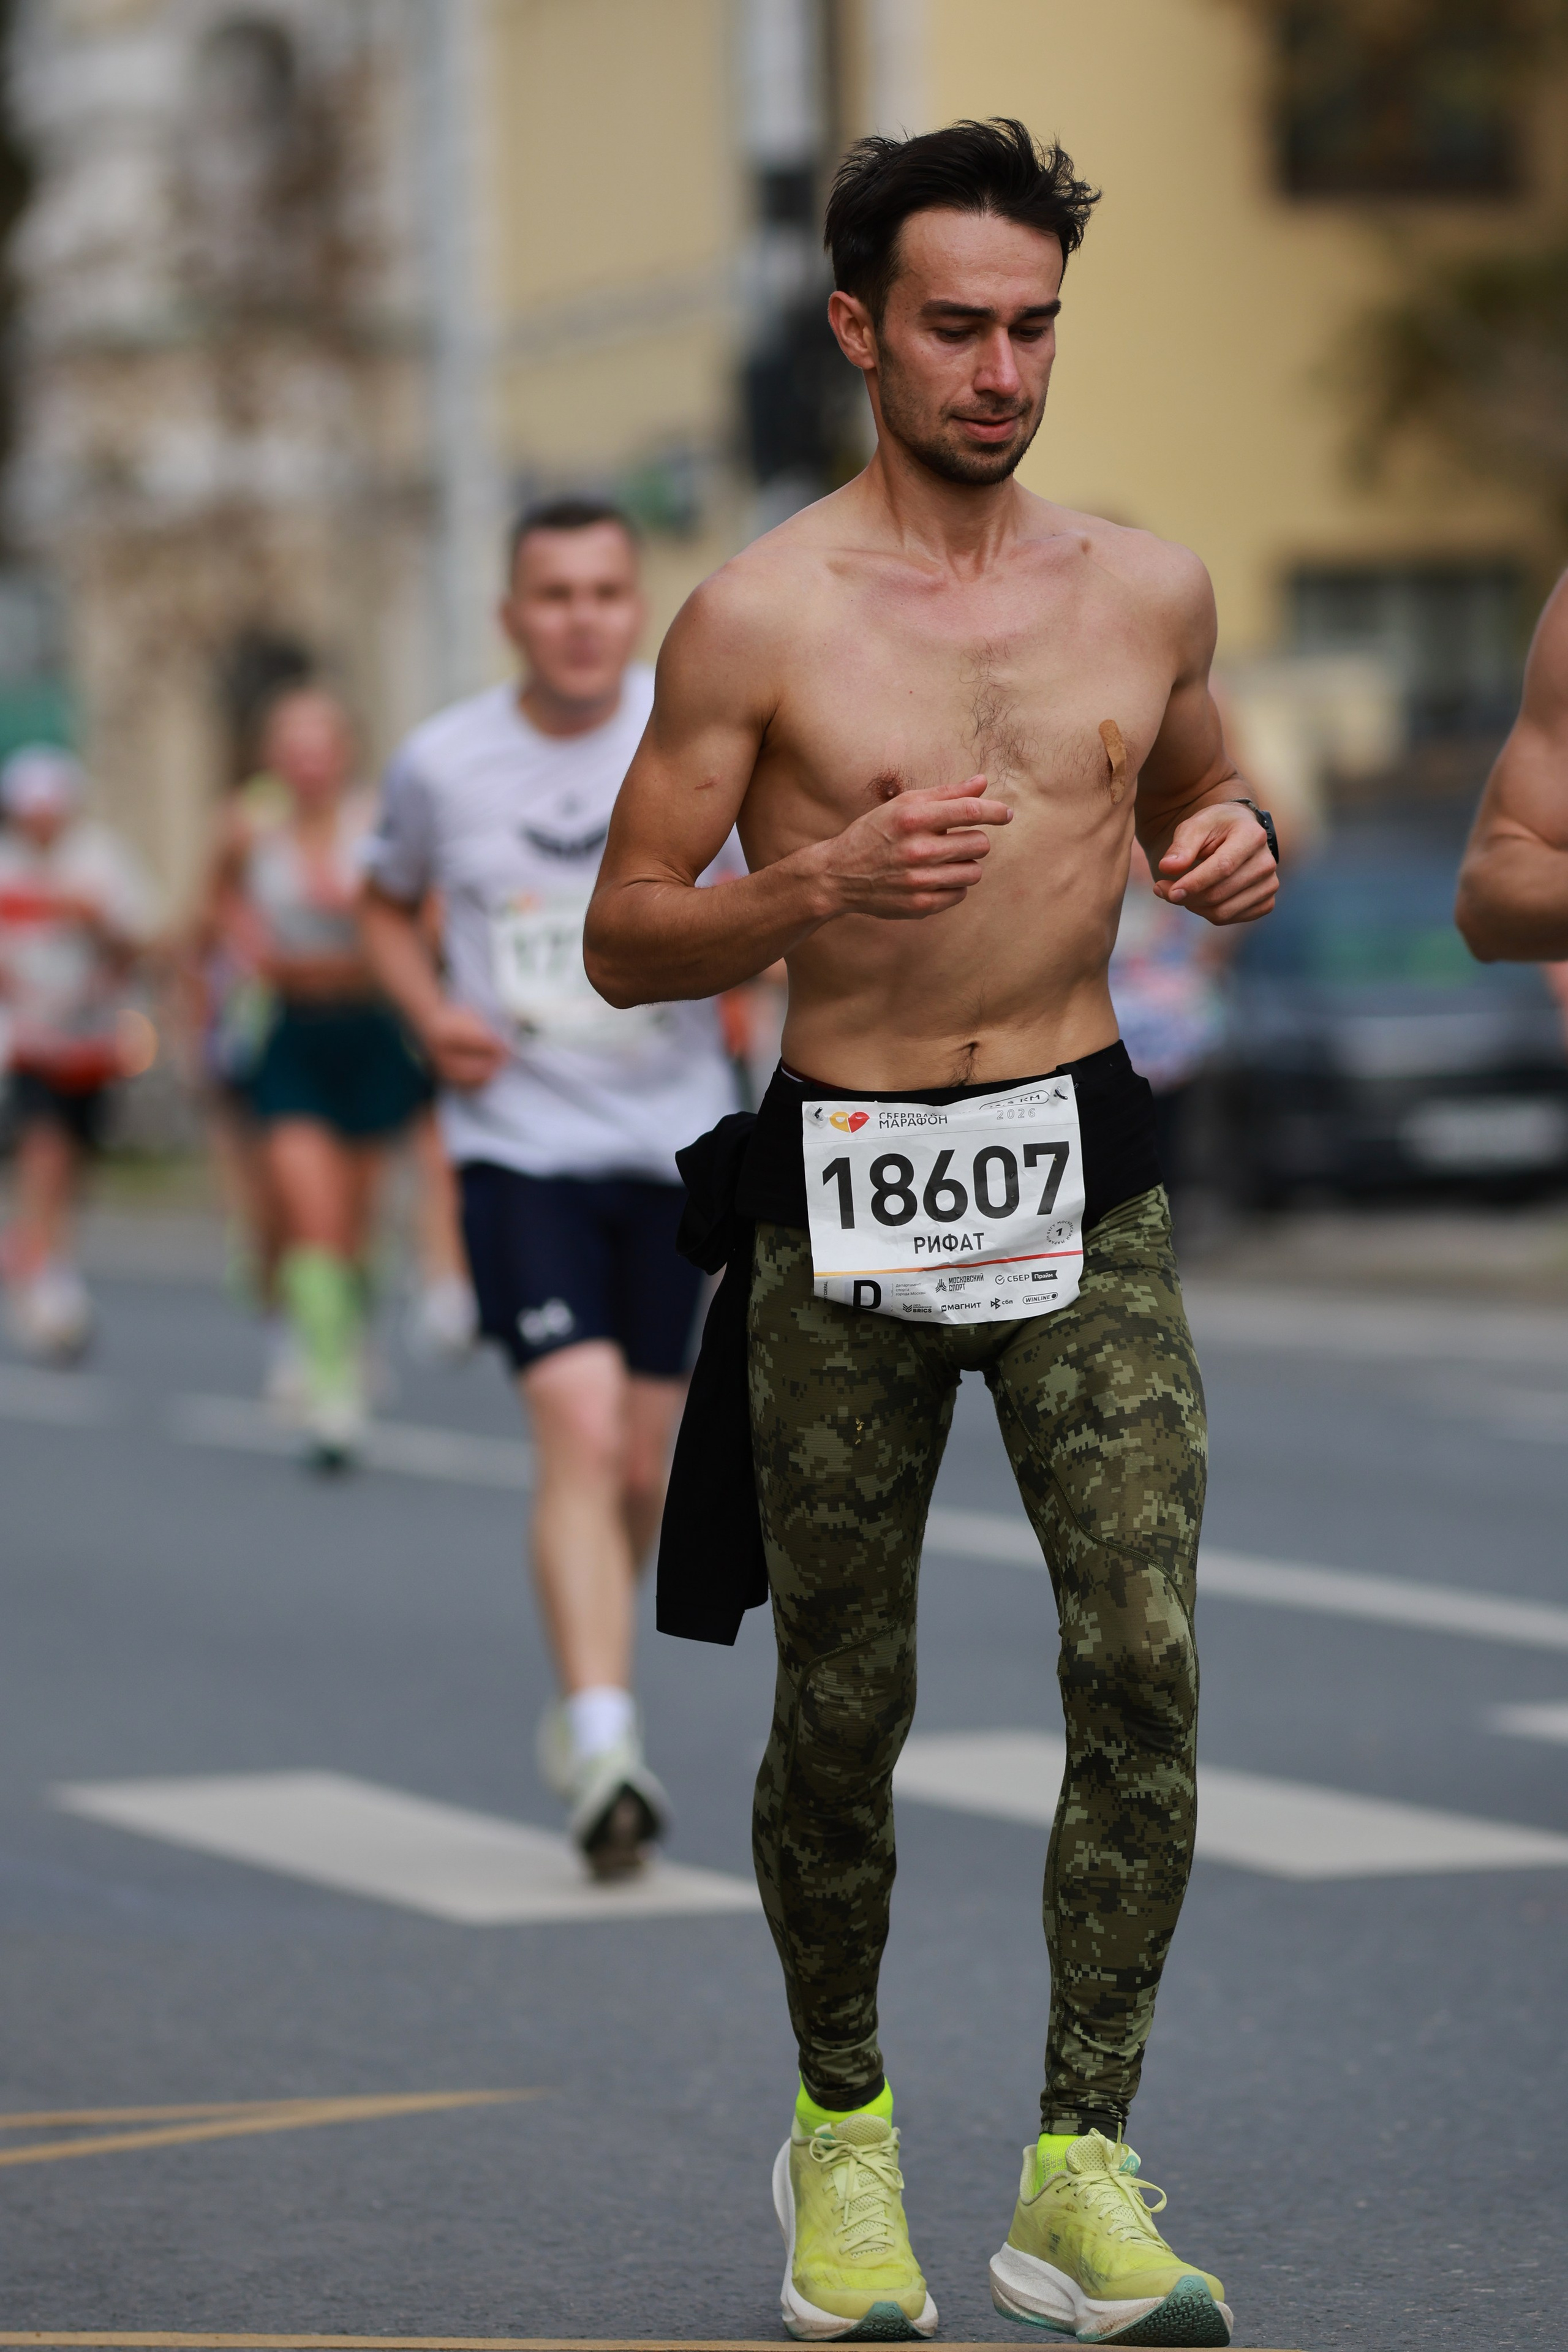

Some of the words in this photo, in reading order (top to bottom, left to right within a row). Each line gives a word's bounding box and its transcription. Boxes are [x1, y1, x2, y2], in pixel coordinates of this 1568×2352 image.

[996, 1107, 1036, 1120] 2026
[879, 1115, 948, 1129] МАРАФОН
[821, 1140, 1070, 1230] 18607
[1056, 1227, 1063, 1236] 1
[914, 1232, 985, 1254] РИФАТ
[948, 1273, 984, 1284] МОСКОВСКИЙ
[1007, 1274, 1030, 1283] СБЕР
[949, 1283, 965, 1292] СПОРТ
[853, 1280, 882, 1310] D
[948, 1302, 981, 1311] магнит
